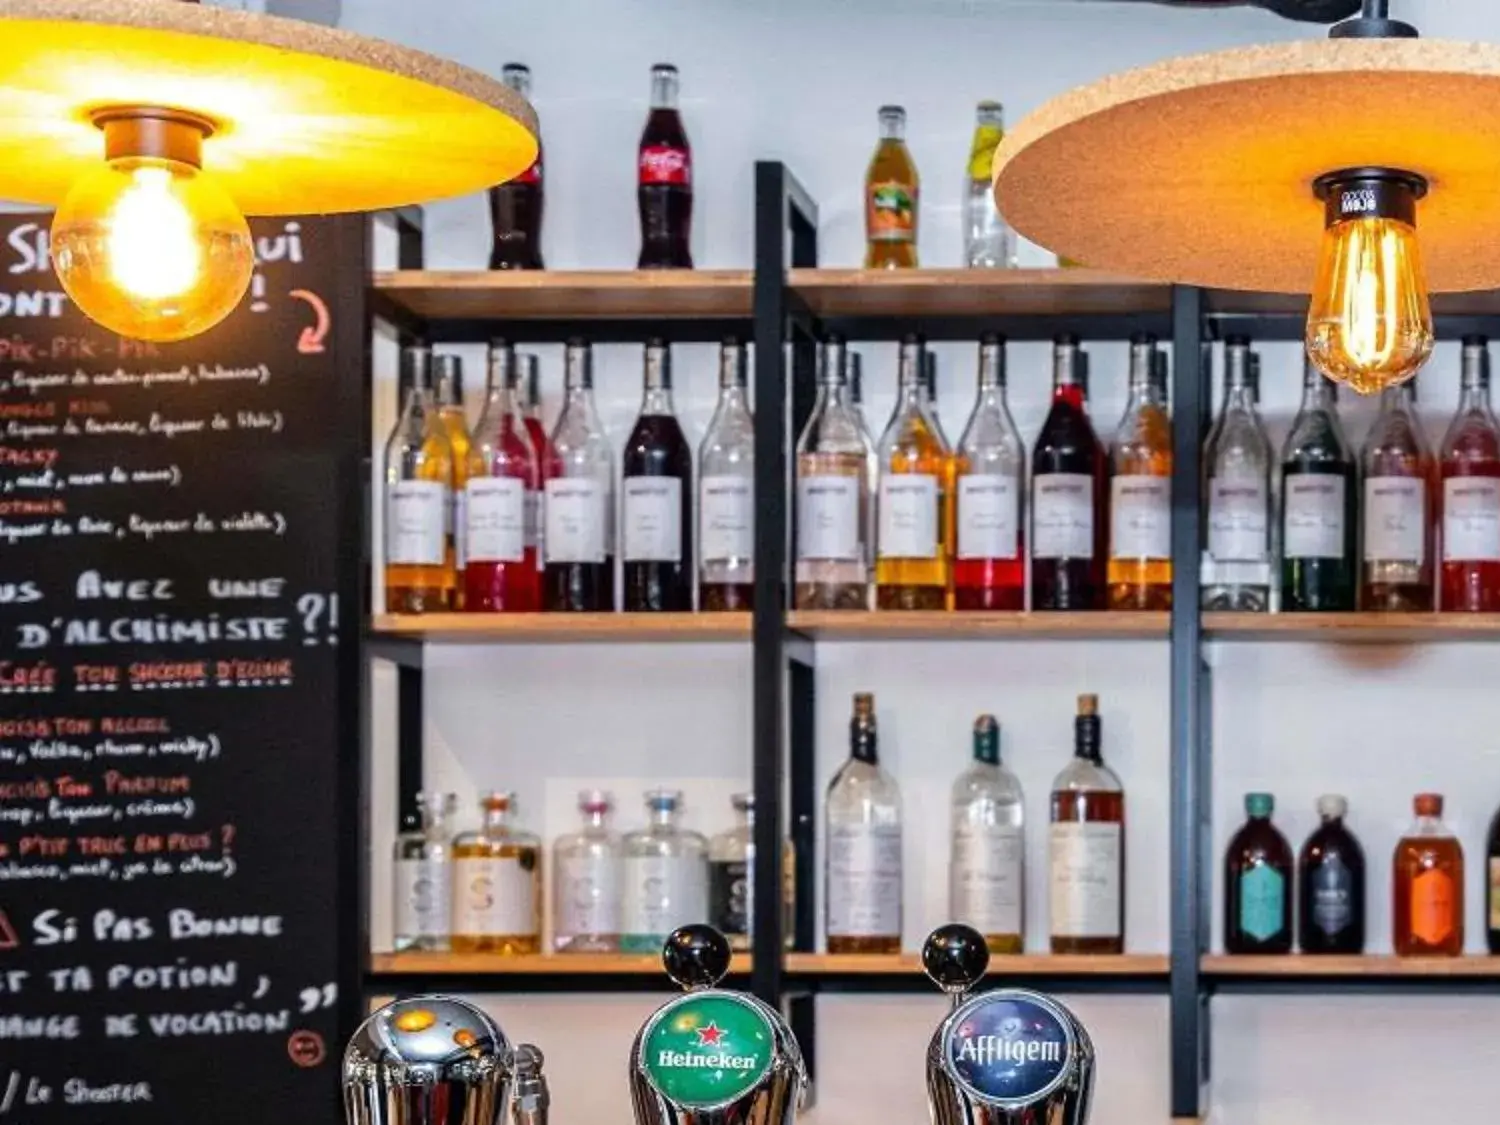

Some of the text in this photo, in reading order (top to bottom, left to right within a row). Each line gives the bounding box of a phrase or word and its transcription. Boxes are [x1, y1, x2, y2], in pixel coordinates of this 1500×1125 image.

[48, 965, 92, 993] TA
[104, 1012, 140, 1039] DE
[658, 1051, 756, 1069] Heineken
[955, 1035, 1061, 1067] Affligem
